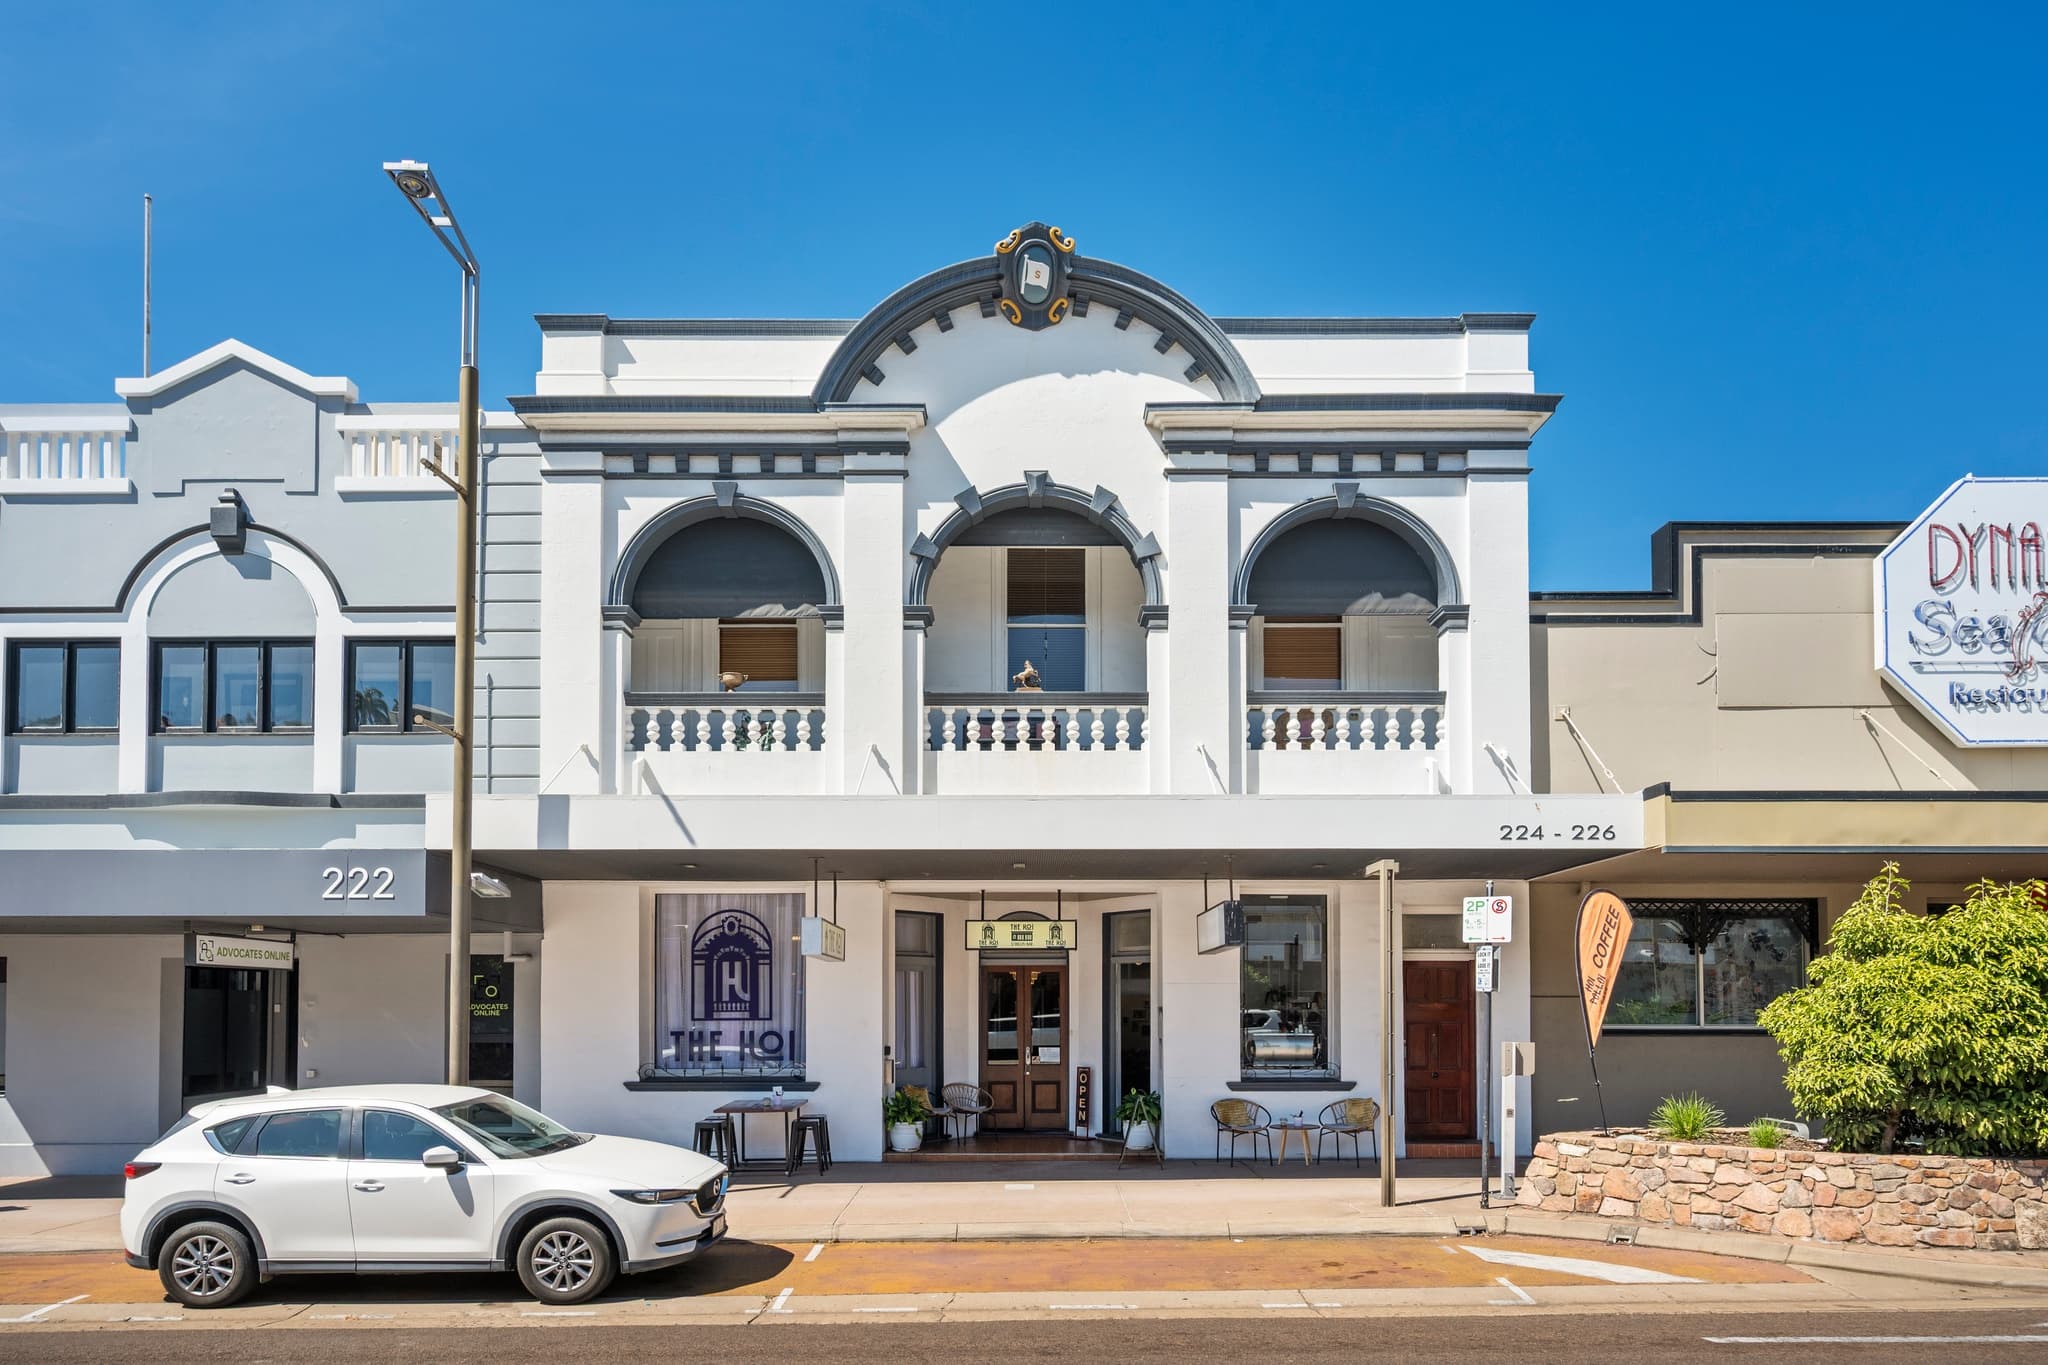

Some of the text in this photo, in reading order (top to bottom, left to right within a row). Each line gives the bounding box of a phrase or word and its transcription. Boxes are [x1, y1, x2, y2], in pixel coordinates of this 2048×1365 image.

[1034, 270, 1041, 279] S
[1928, 522, 2048, 591] DYNA
[1499, 824, 1544, 841] 224
[1571, 824, 1616, 841] 226
[322, 866, 395, 900] 222
[1466, 900, 1485, 912] 2P
[1592, 904, 1620, 969] COFFEE
[216, 946, 290, 961] ADVOCATES ONLINE
[670, 1030, 795, 1062] THE HOI
[1079, 1073, 1088, 1121] OPEN
